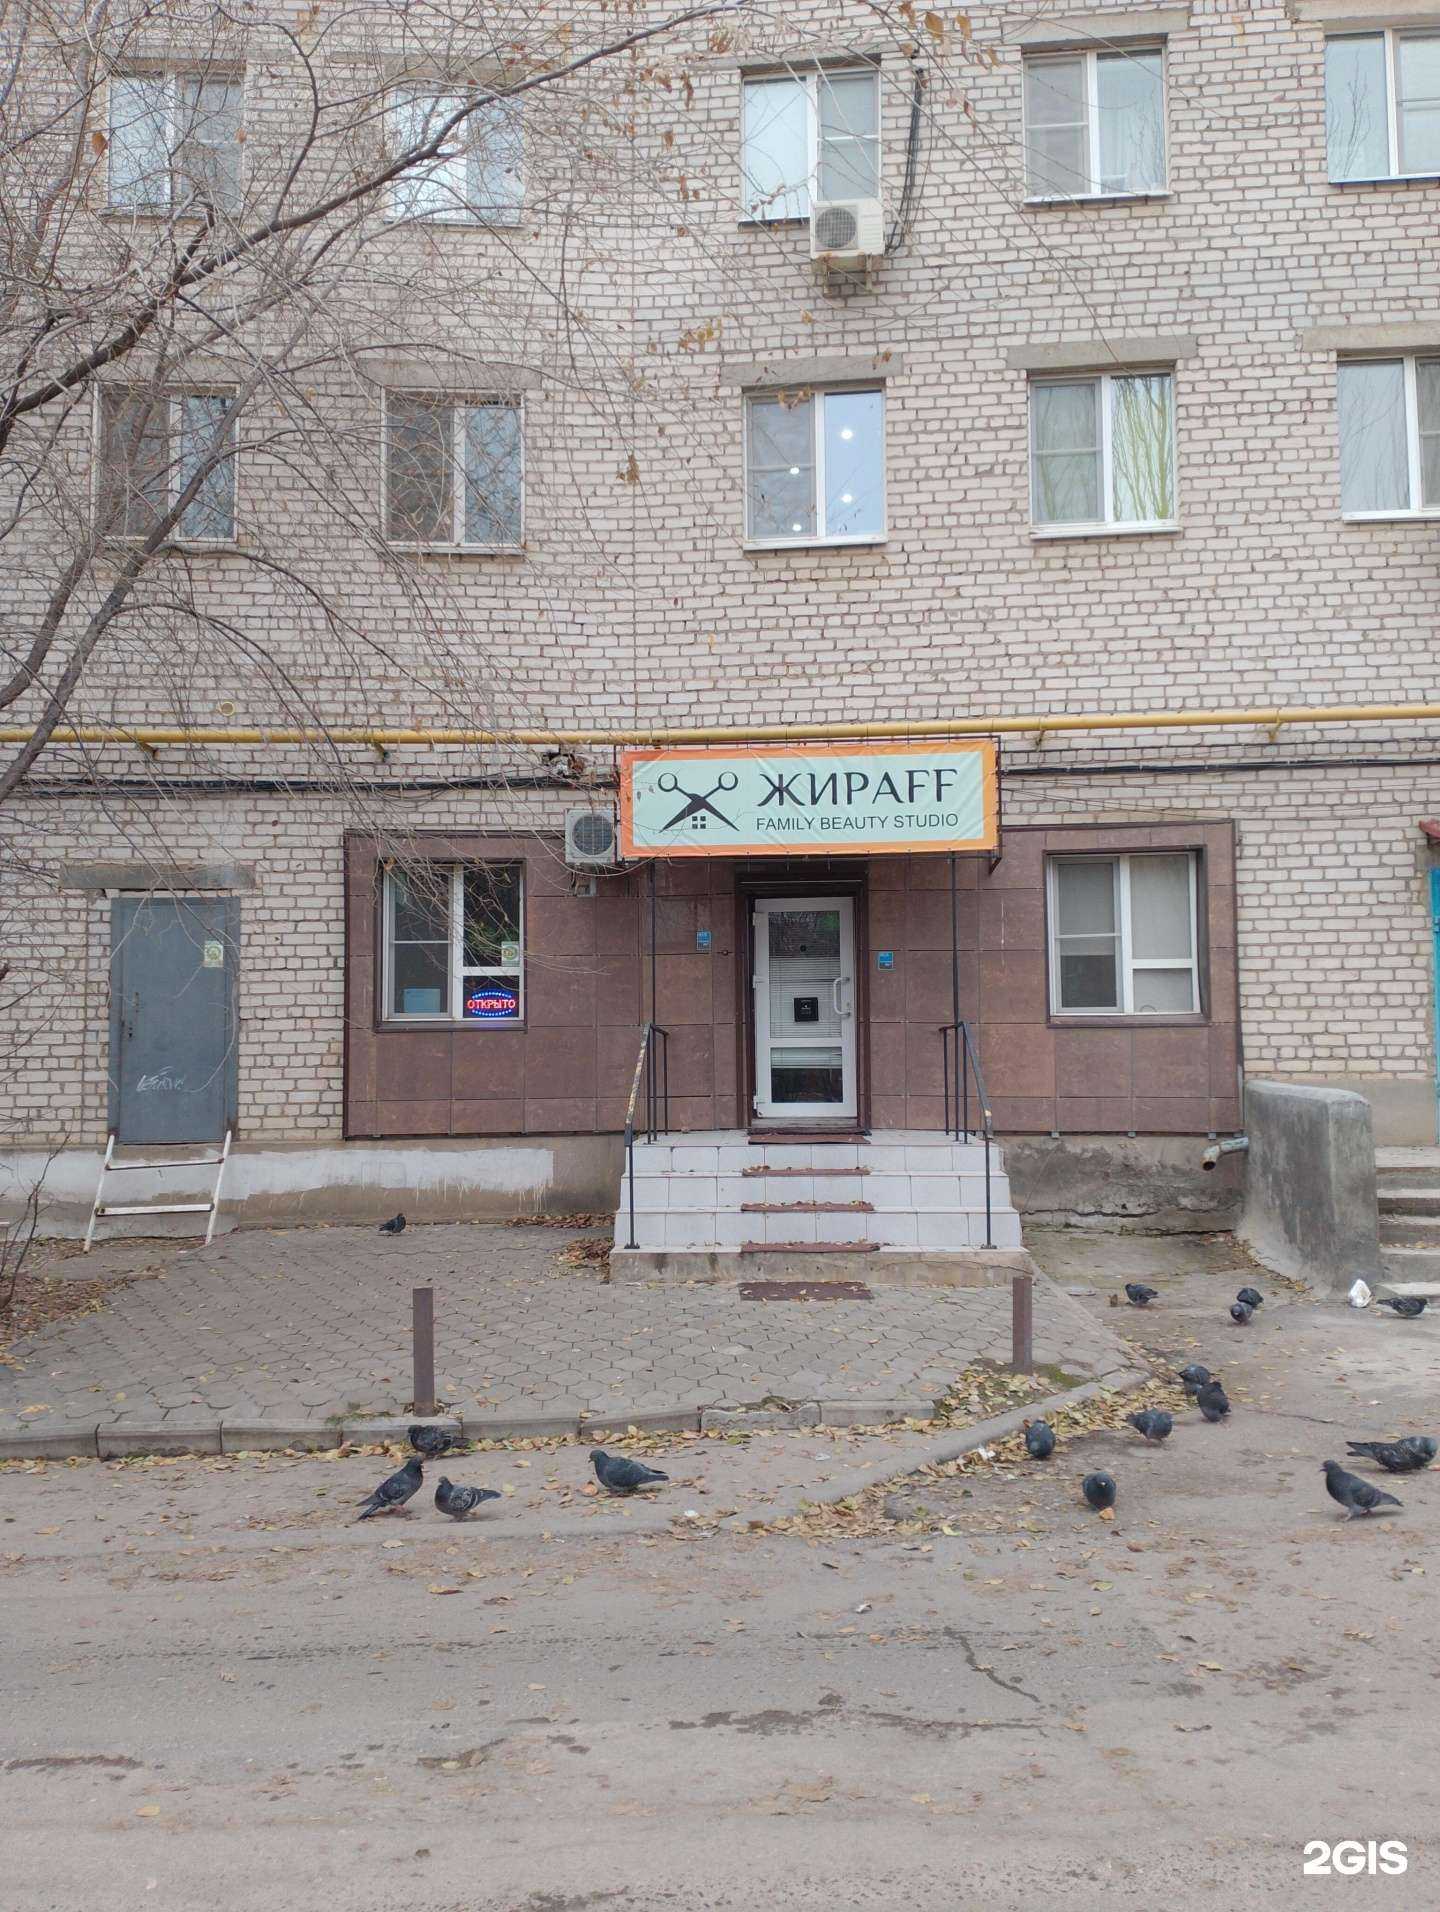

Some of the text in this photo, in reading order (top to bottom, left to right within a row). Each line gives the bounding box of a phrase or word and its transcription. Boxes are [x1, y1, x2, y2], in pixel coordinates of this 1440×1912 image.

[757, 768, 958, 807] ЖИРАFF
[756, 813, 959, 831] FAMILY BEAUTY STUDIO
[467, 999, 516, 1009] ОТКРЫТО
